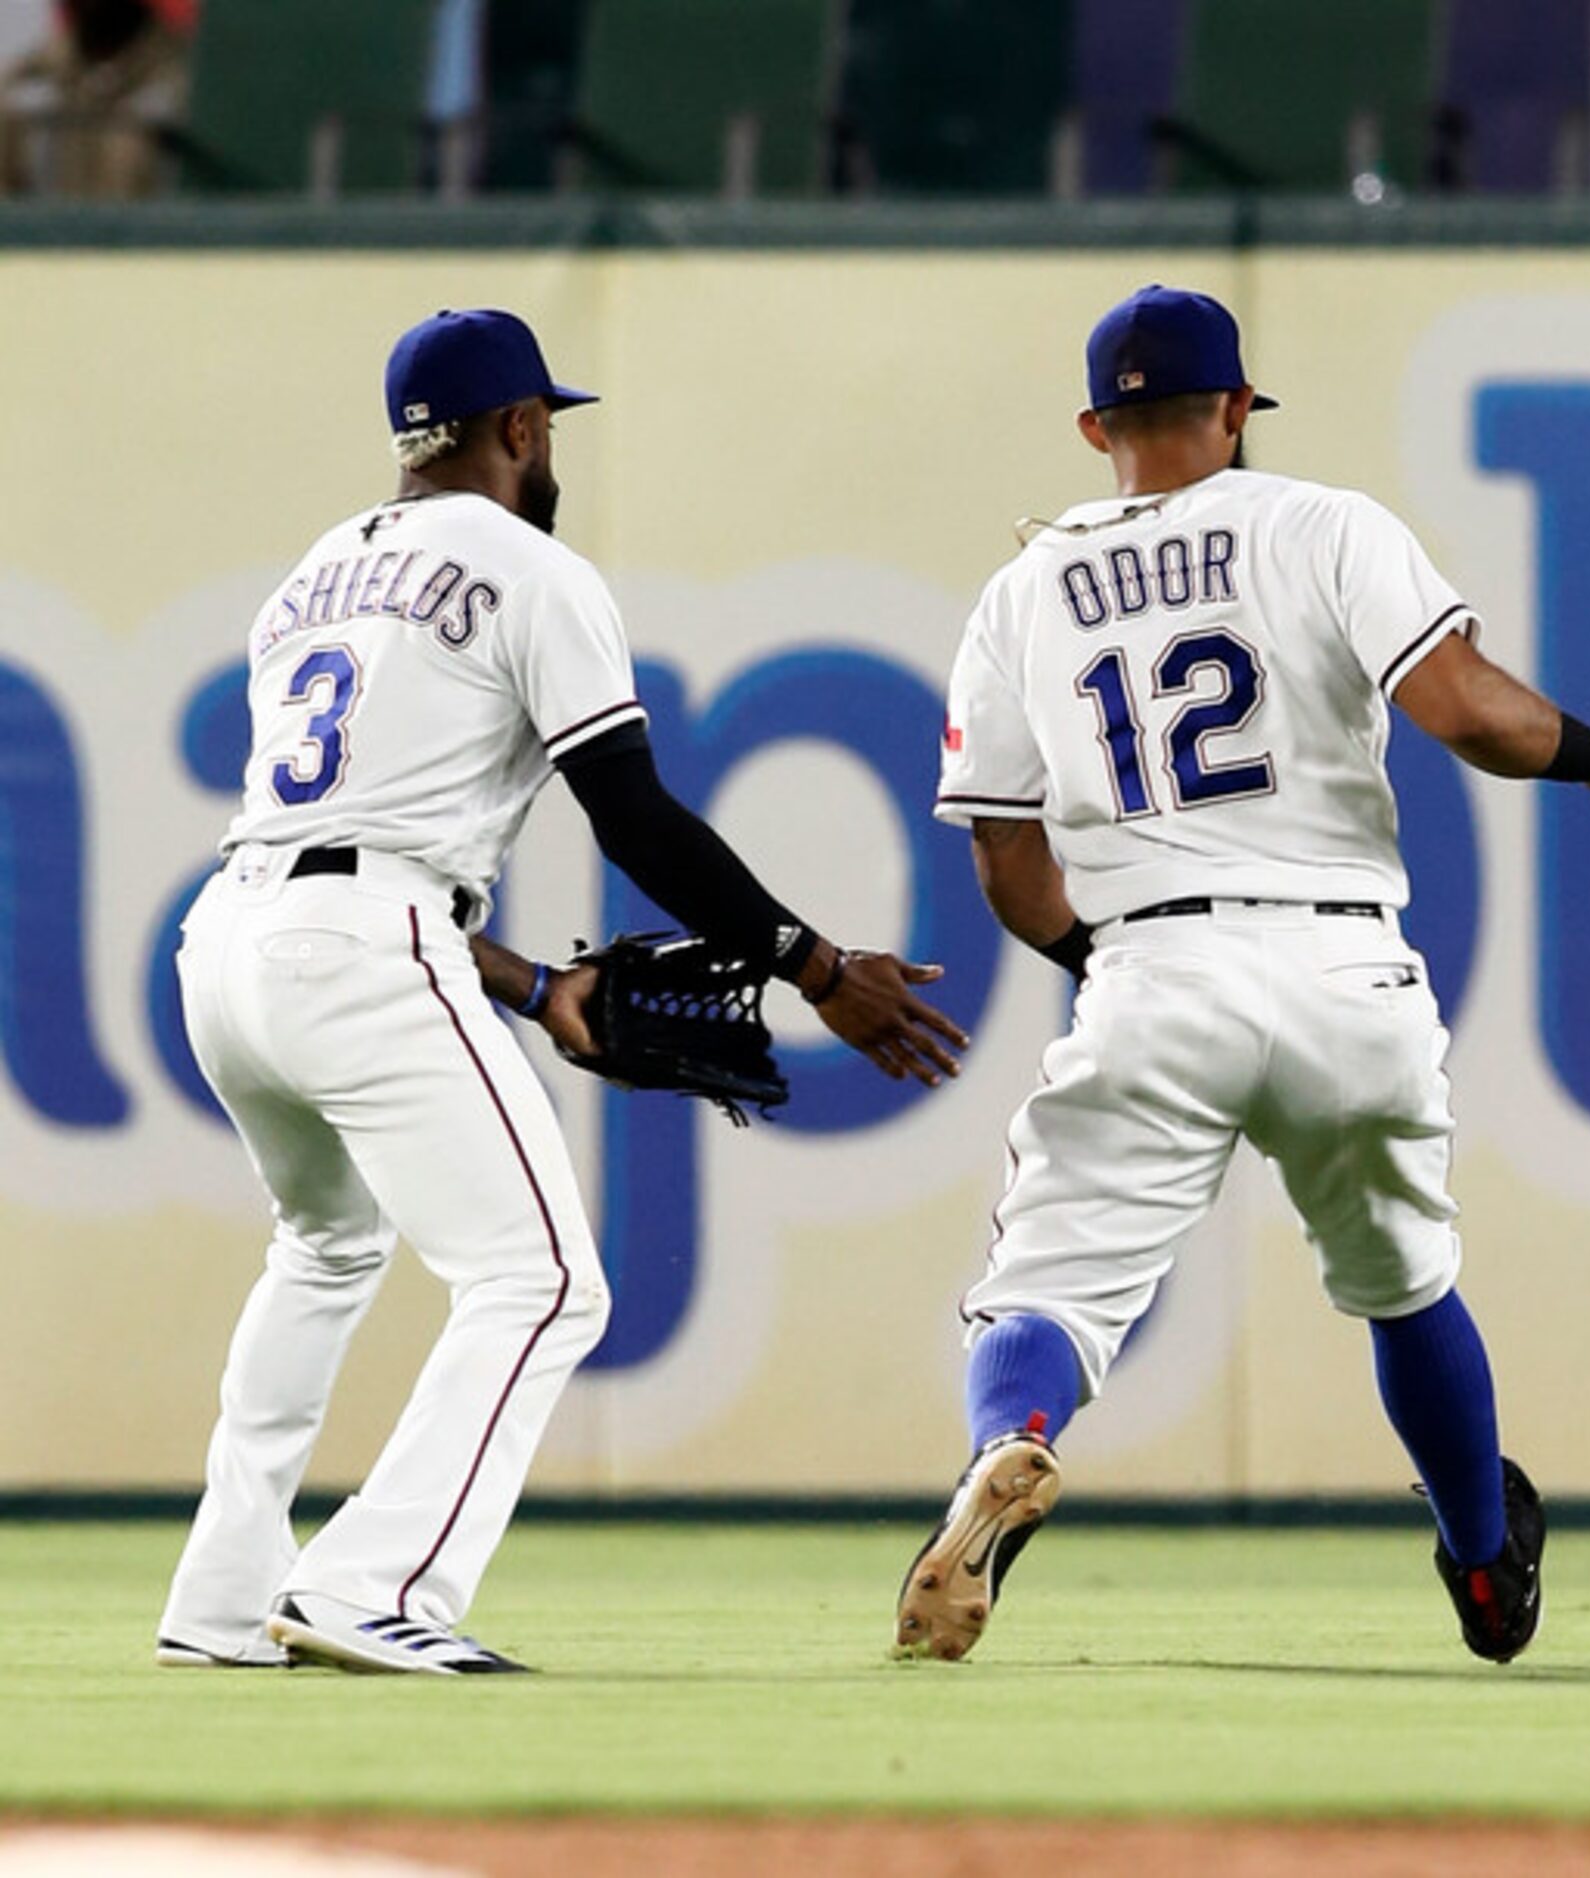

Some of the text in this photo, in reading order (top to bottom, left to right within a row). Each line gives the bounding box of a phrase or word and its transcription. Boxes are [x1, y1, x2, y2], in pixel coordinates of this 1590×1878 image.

[258, 550, 502, 652] SHIELDS
[1060, 528, 1238, 632] ODOR
[272, 642, 364, 807] 3
[1074, 627, 1277, 822] 12
